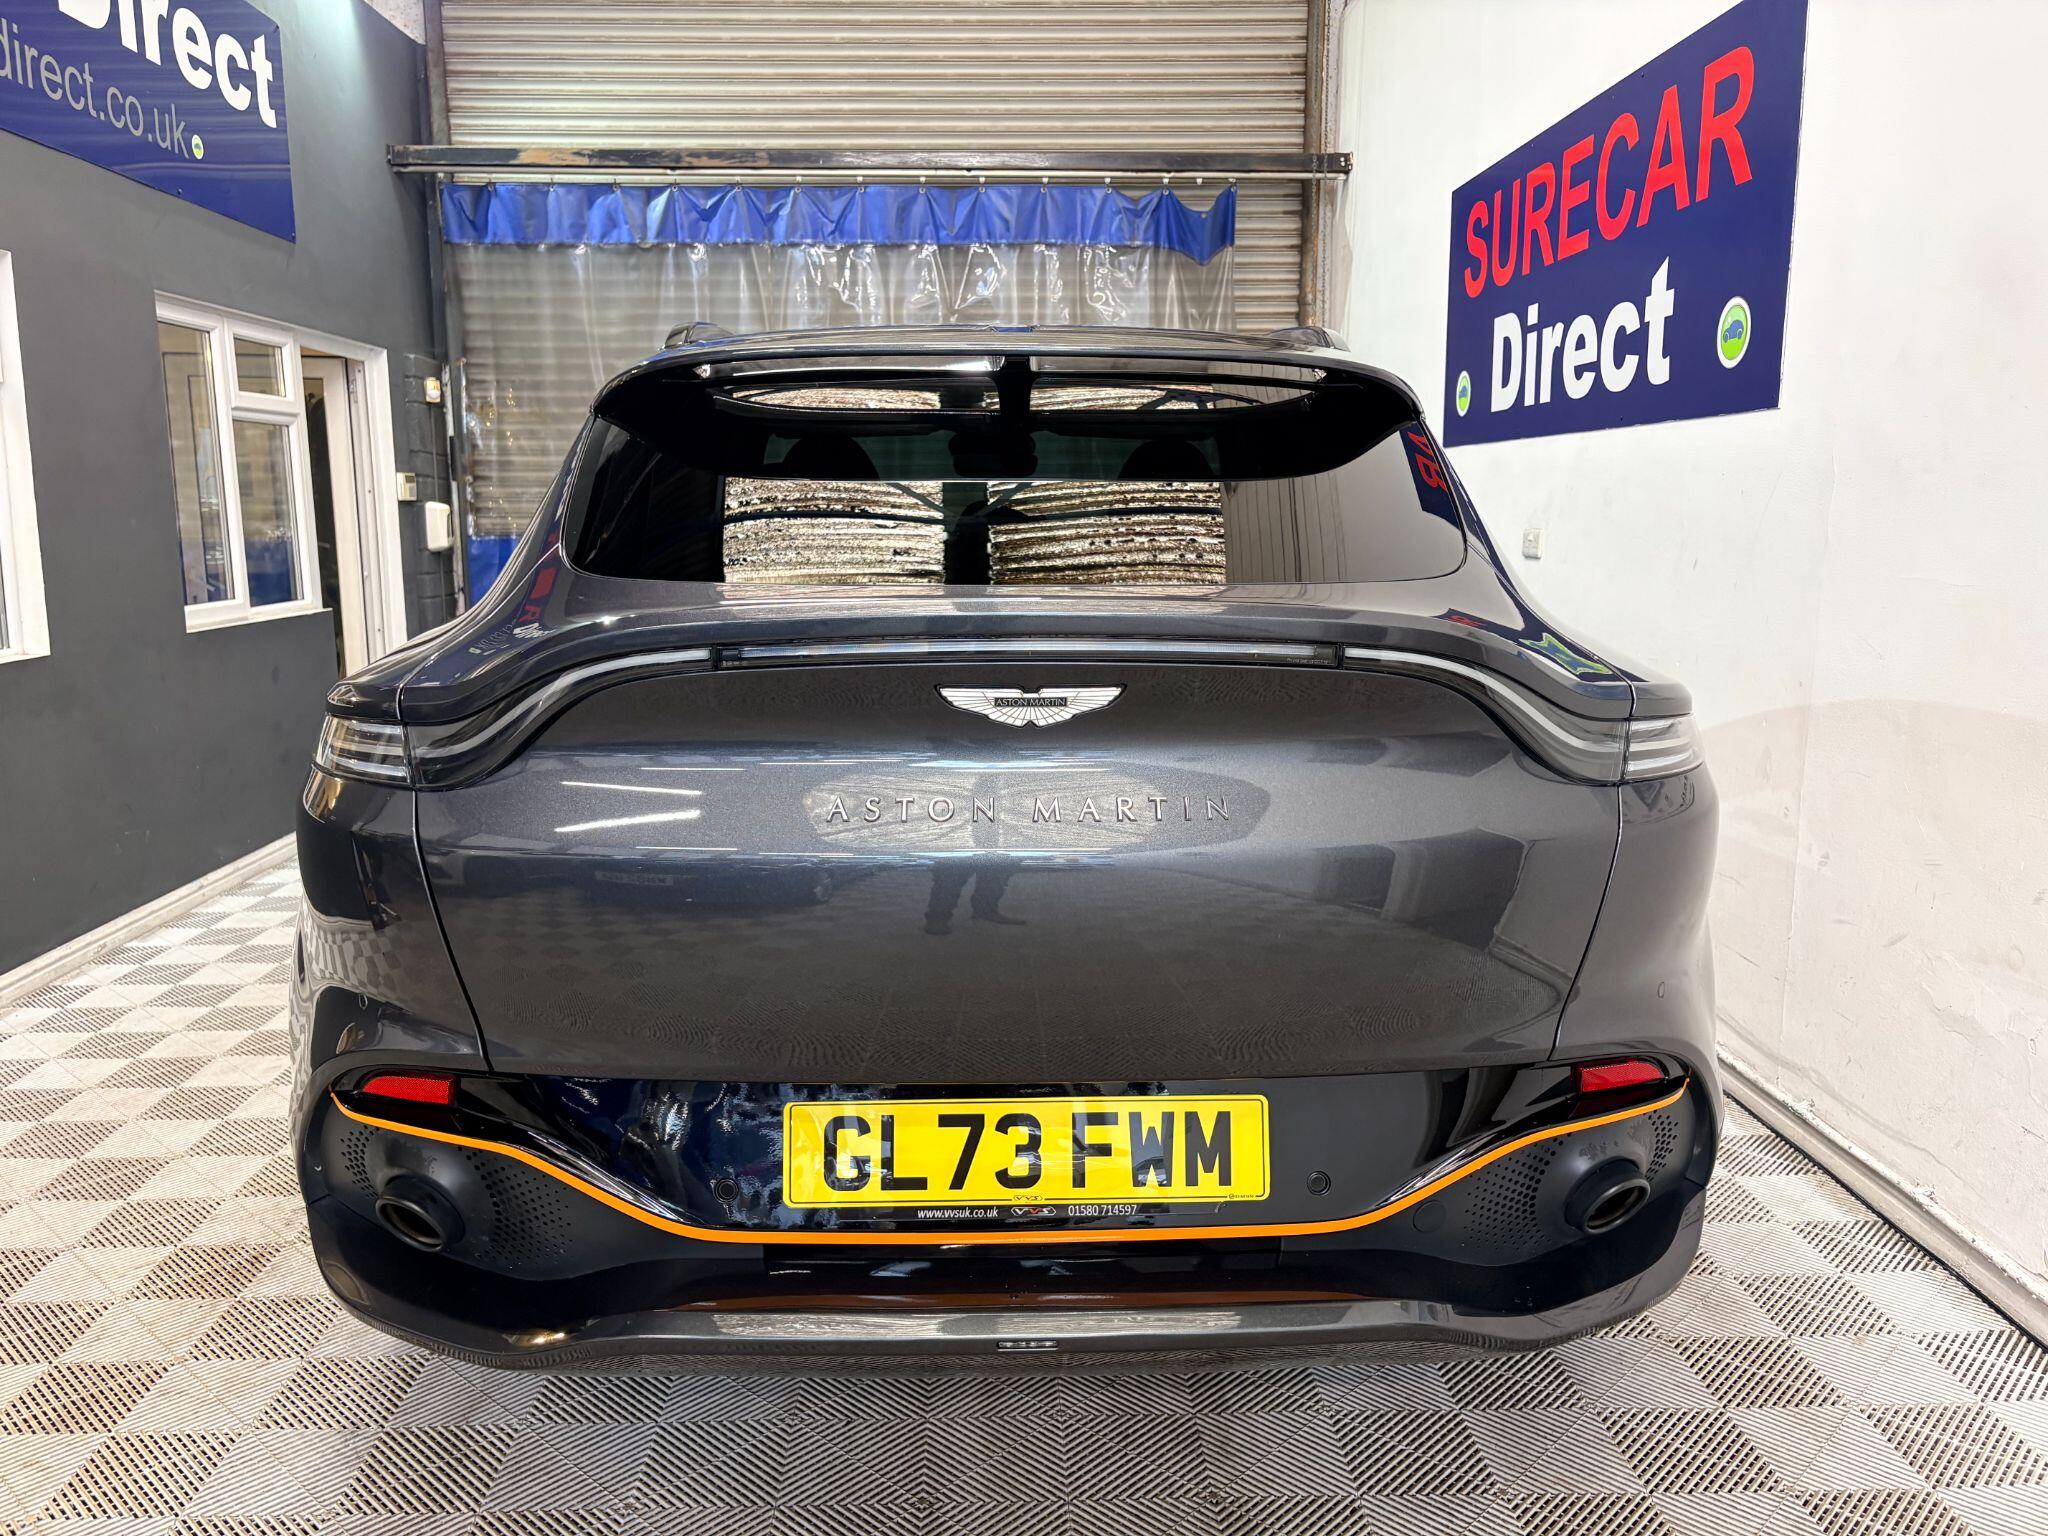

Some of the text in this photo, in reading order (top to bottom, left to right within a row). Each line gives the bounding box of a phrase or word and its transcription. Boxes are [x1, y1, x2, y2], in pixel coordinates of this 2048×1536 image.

[1464, 46, 1755, 298] SURECAR
[1490, 256, 1675, 412] Direct
[996, 698, 1066, 706] ASTON MARTIN
[826, 796, 1231, 823] ASTON MARTIN
[823, 1110, 1232, 1192] GL73 FWM
[917, 1206, 998, 1219] www.vvsuk.co.uk
[1068, 1204, 1099, 1216] 01580
[1101, 1204, 1137, 1216] 714597
